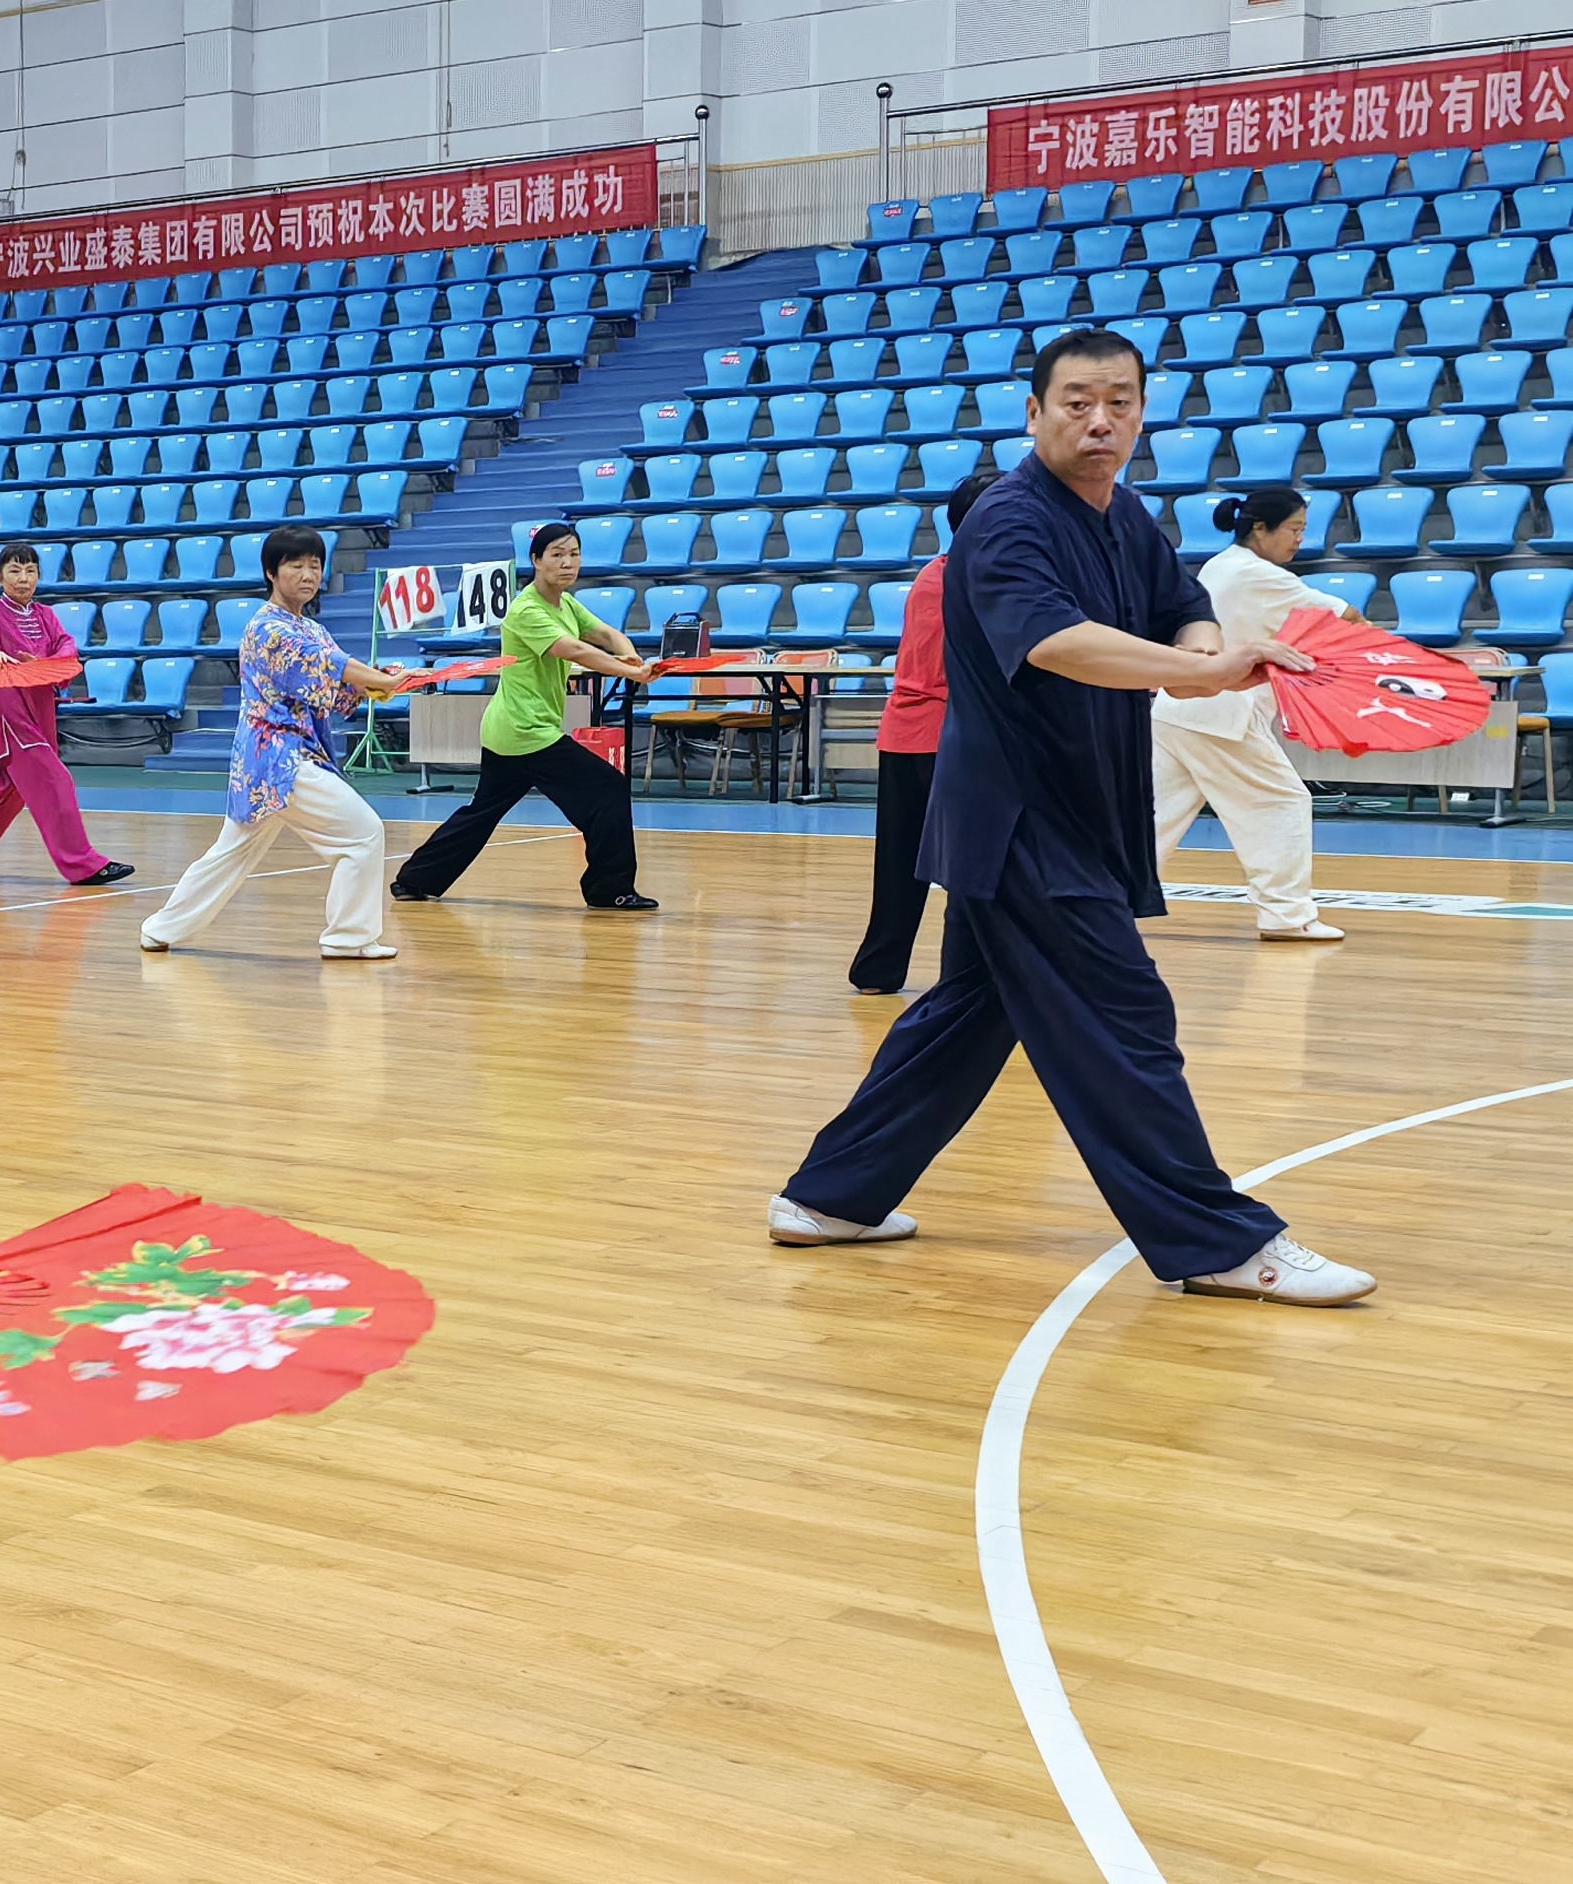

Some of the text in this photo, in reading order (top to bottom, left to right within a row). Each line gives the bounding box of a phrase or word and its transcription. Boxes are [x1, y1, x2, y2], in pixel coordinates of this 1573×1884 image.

[1028, 65, 1571, 175] 宁波嘉乐智能科技股份有限公
[379, 565, 436, 630] 118
